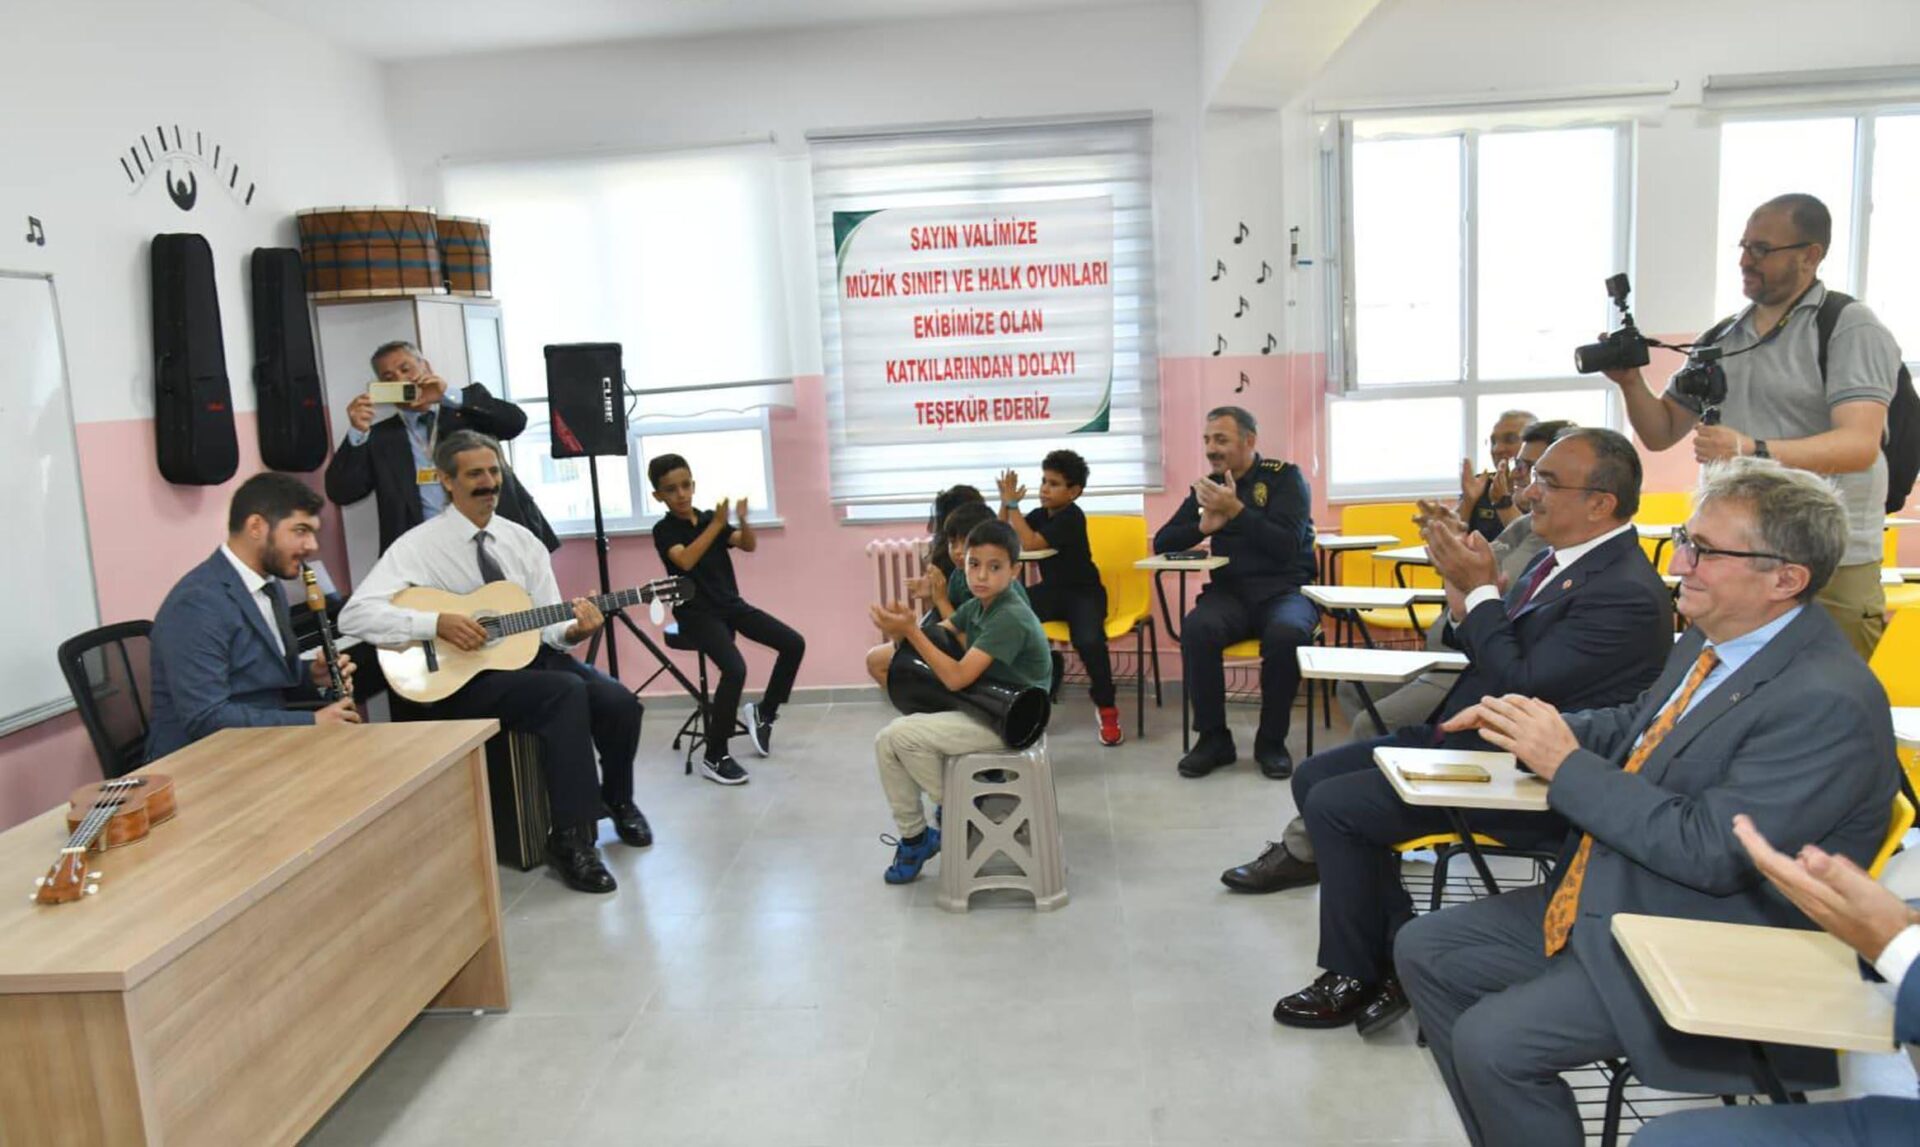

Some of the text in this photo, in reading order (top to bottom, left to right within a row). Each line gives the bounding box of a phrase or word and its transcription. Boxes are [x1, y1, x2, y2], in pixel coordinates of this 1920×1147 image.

[911, 217, 1038, 251] SAYIN VALİMİZE
[846, 261, 1108, 299] MÜZİK SINIFI VE HALK OYUNLARI
[914, 308, 1044, 339] EKİBİMİZE OLAN
[886, 351, 1076, 384] KATKILARINDAN DOLAYI
[602, 377, 613, 423] CUBE
[914, 391, 1051, 431] TEŞEKÜR EDERİZ
